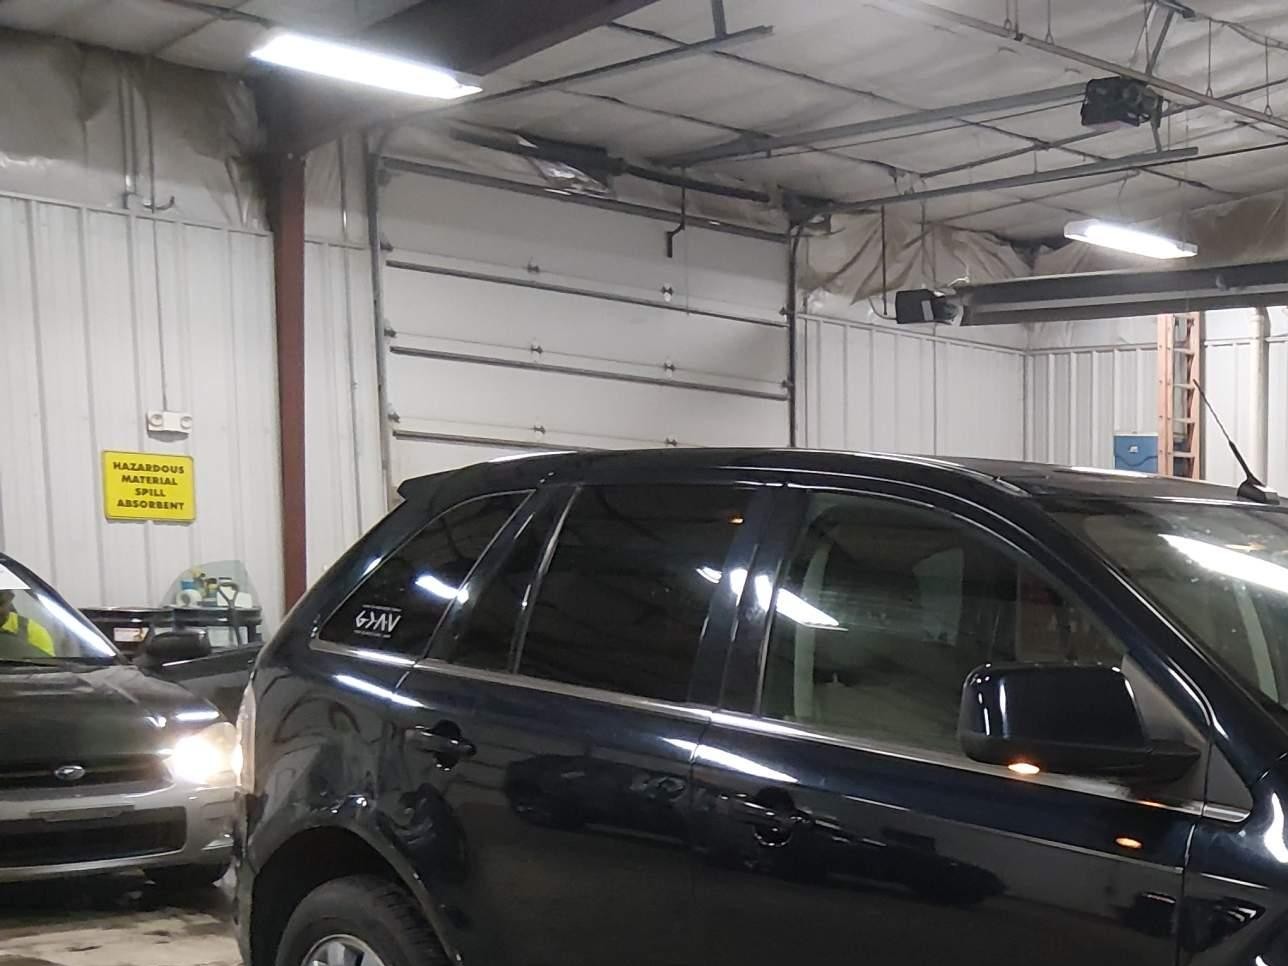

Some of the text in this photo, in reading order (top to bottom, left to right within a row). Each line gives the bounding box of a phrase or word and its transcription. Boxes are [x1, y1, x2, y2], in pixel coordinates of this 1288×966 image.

[113, 461, 185, 474] HAZARDOUS
[121, 474, 178, 486] MATERIAL
[135, 487, 167, 497] SPILL
[116, 499, 185, 510] ABSORBENT
